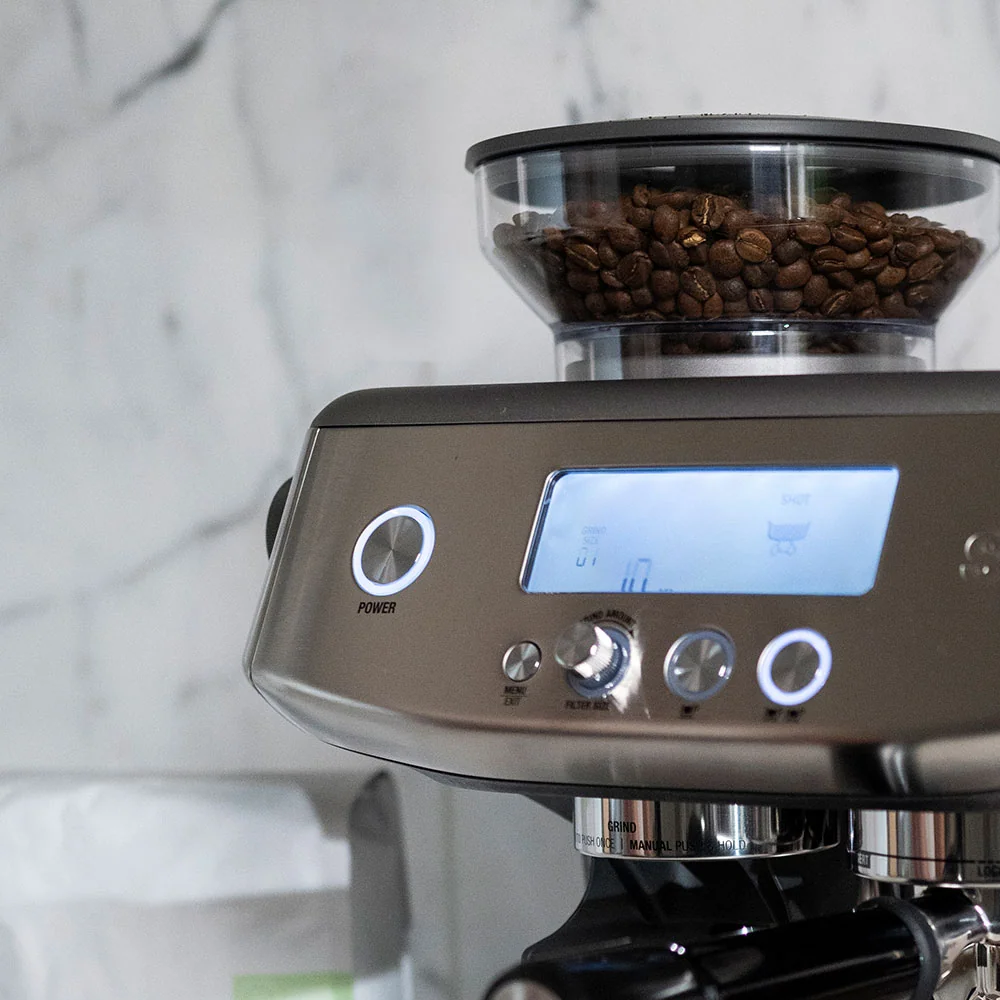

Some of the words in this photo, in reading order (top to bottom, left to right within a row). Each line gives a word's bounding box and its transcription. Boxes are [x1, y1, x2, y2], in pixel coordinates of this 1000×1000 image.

[357, 602, 397, 614] POWER
[607, 821, 637, 834] GRIND
[581, 833, 595, 847] PUSH
[595, 836, 617, 850] ONCE
[629, 839, 673, 852] MANUAL
[717, 839, 747, 851] HOLD
